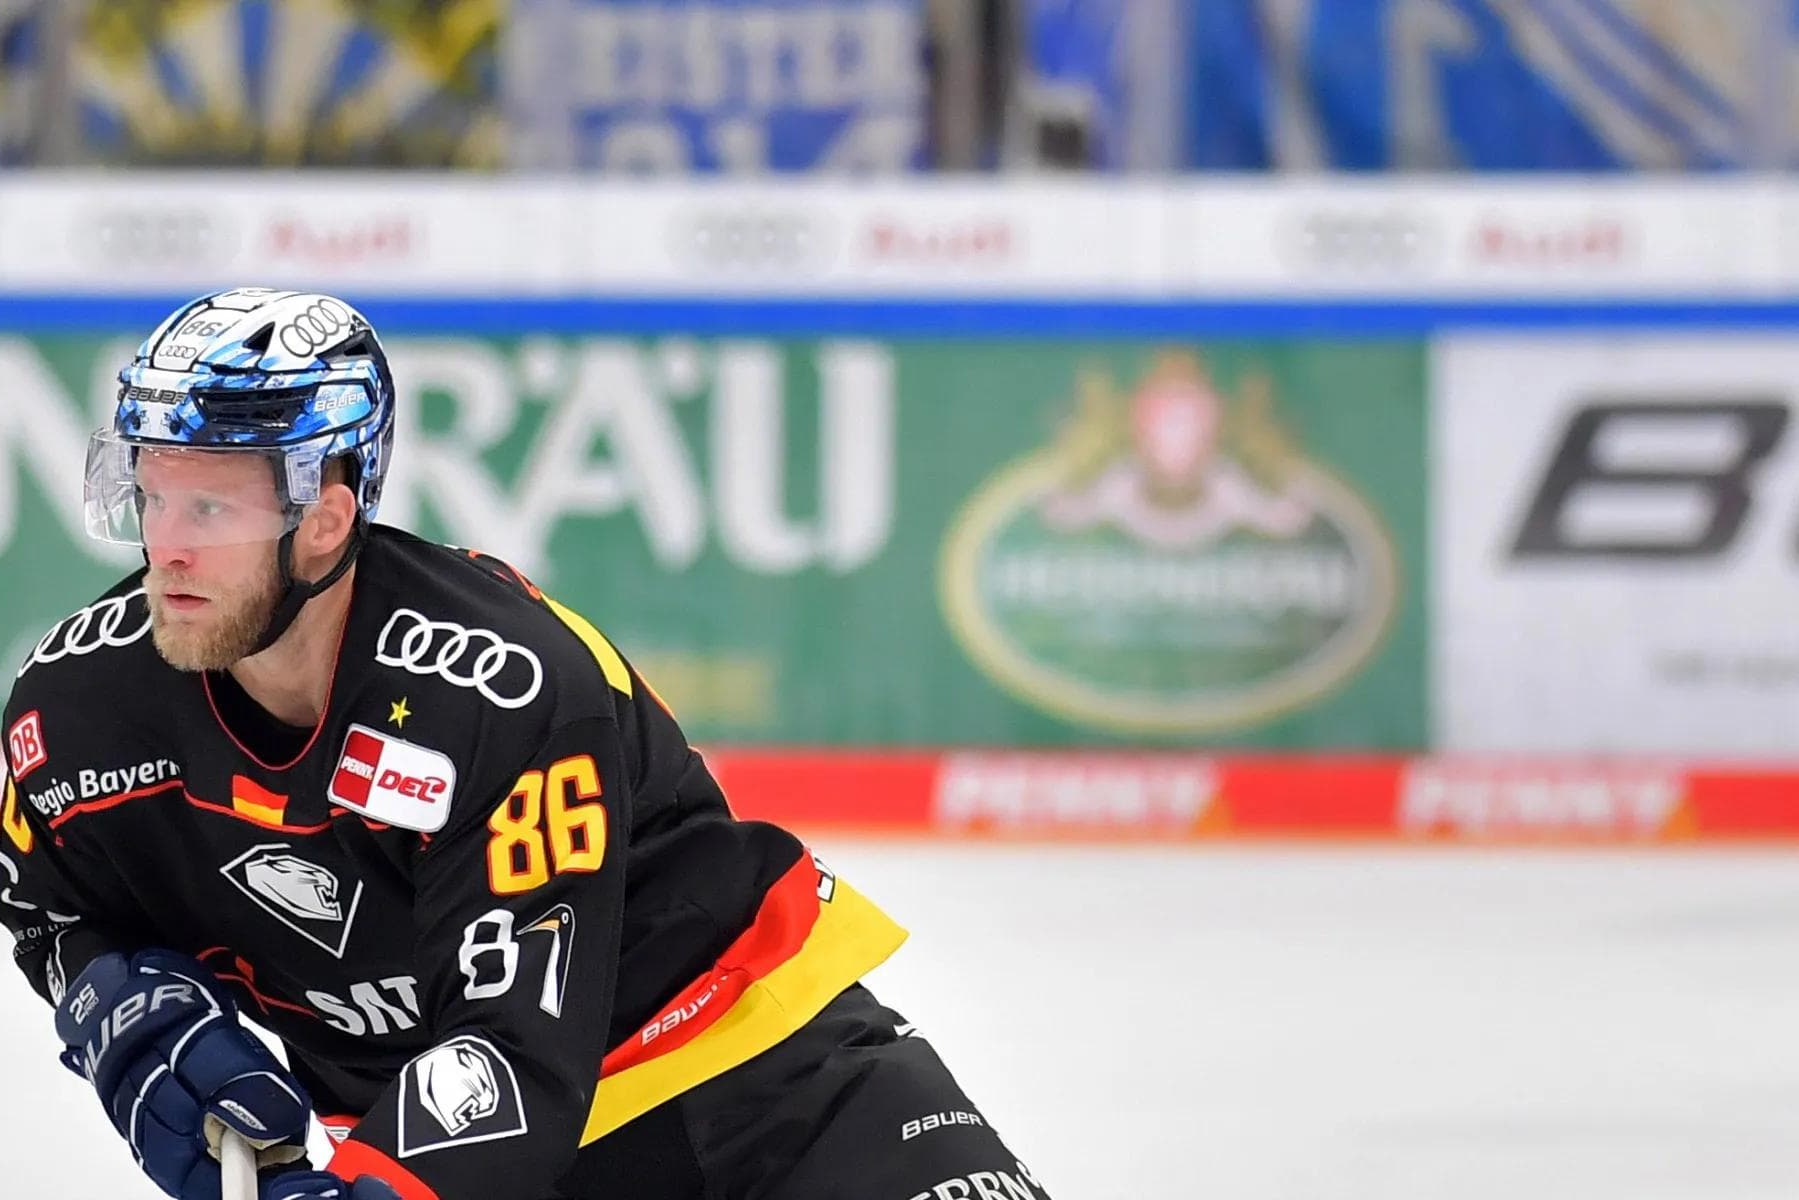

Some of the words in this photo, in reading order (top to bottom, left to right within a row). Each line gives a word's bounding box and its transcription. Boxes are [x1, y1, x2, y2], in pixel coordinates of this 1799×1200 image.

[390, 333, 897, 584] RÄU
[486, 753, 608, 895] 86
[902, 1111, 983, 1141] BAUER
